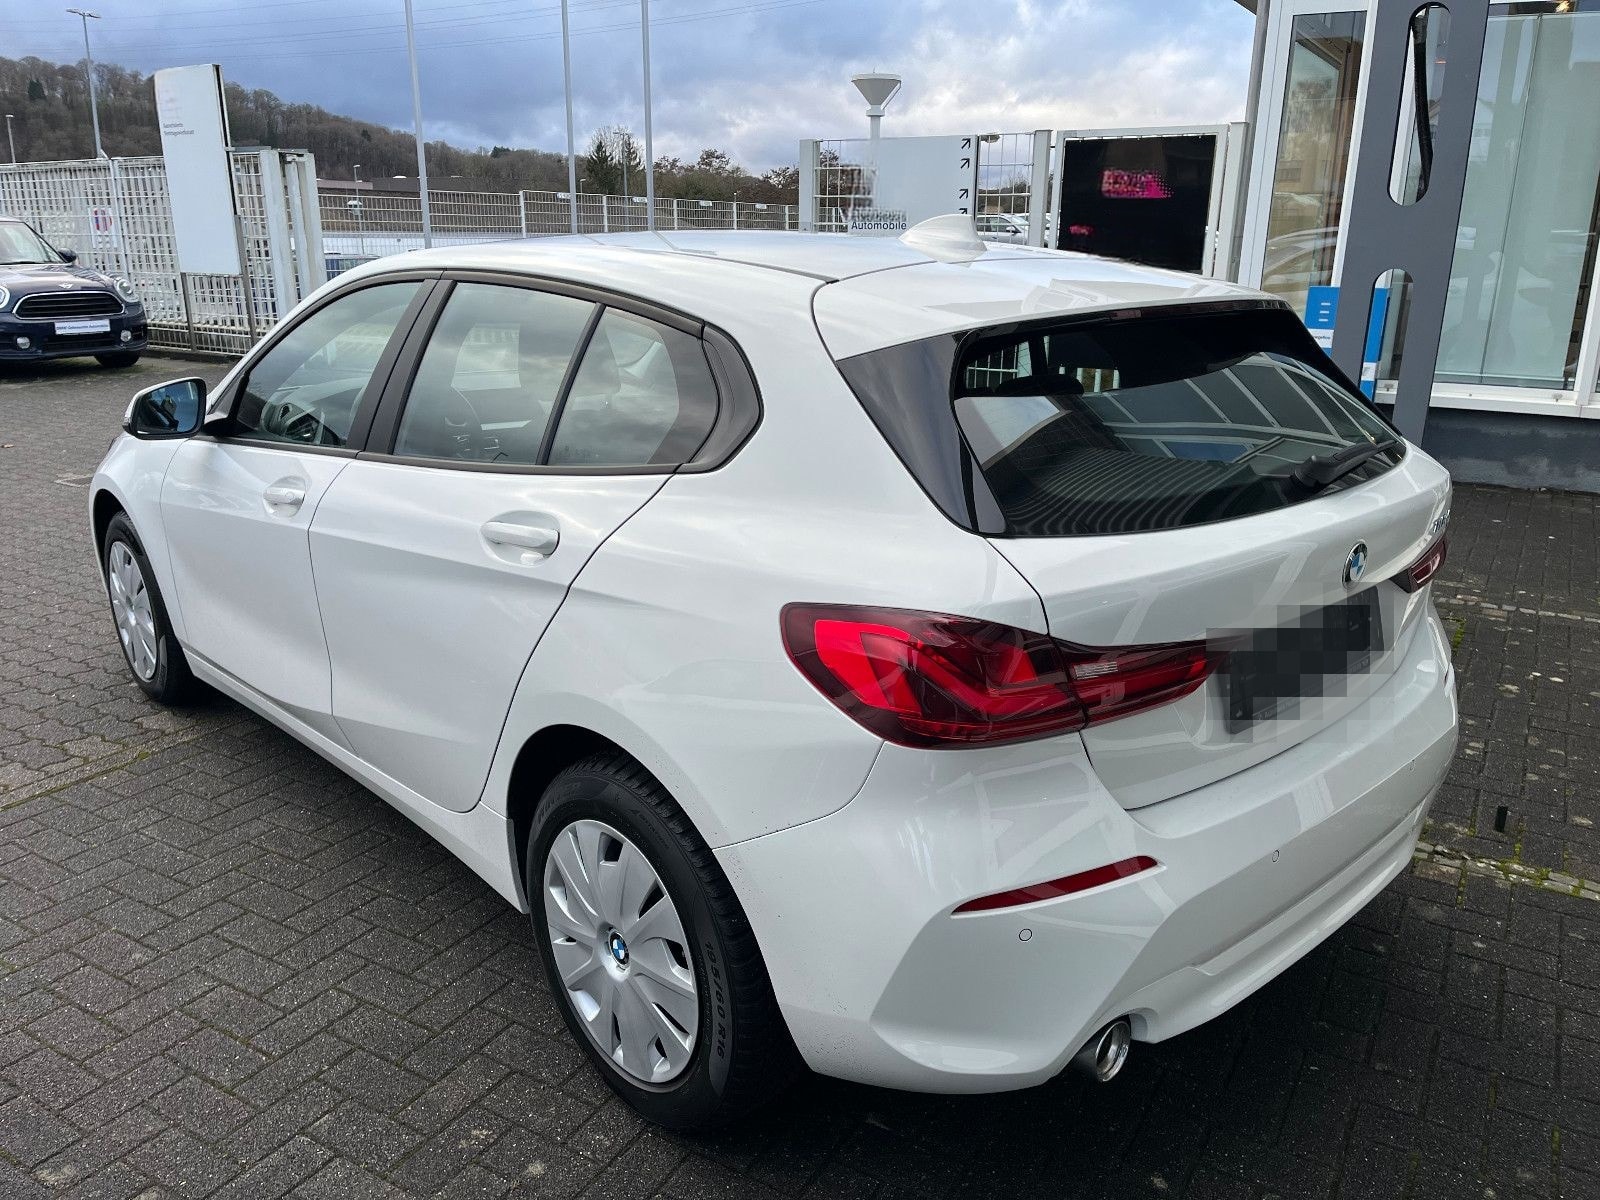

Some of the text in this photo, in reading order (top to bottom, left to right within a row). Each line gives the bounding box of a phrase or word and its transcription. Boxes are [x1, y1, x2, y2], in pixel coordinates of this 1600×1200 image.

[851, 221, 907, 230] Automobile
[705, 942, 726, 1059] 195/60 R16
